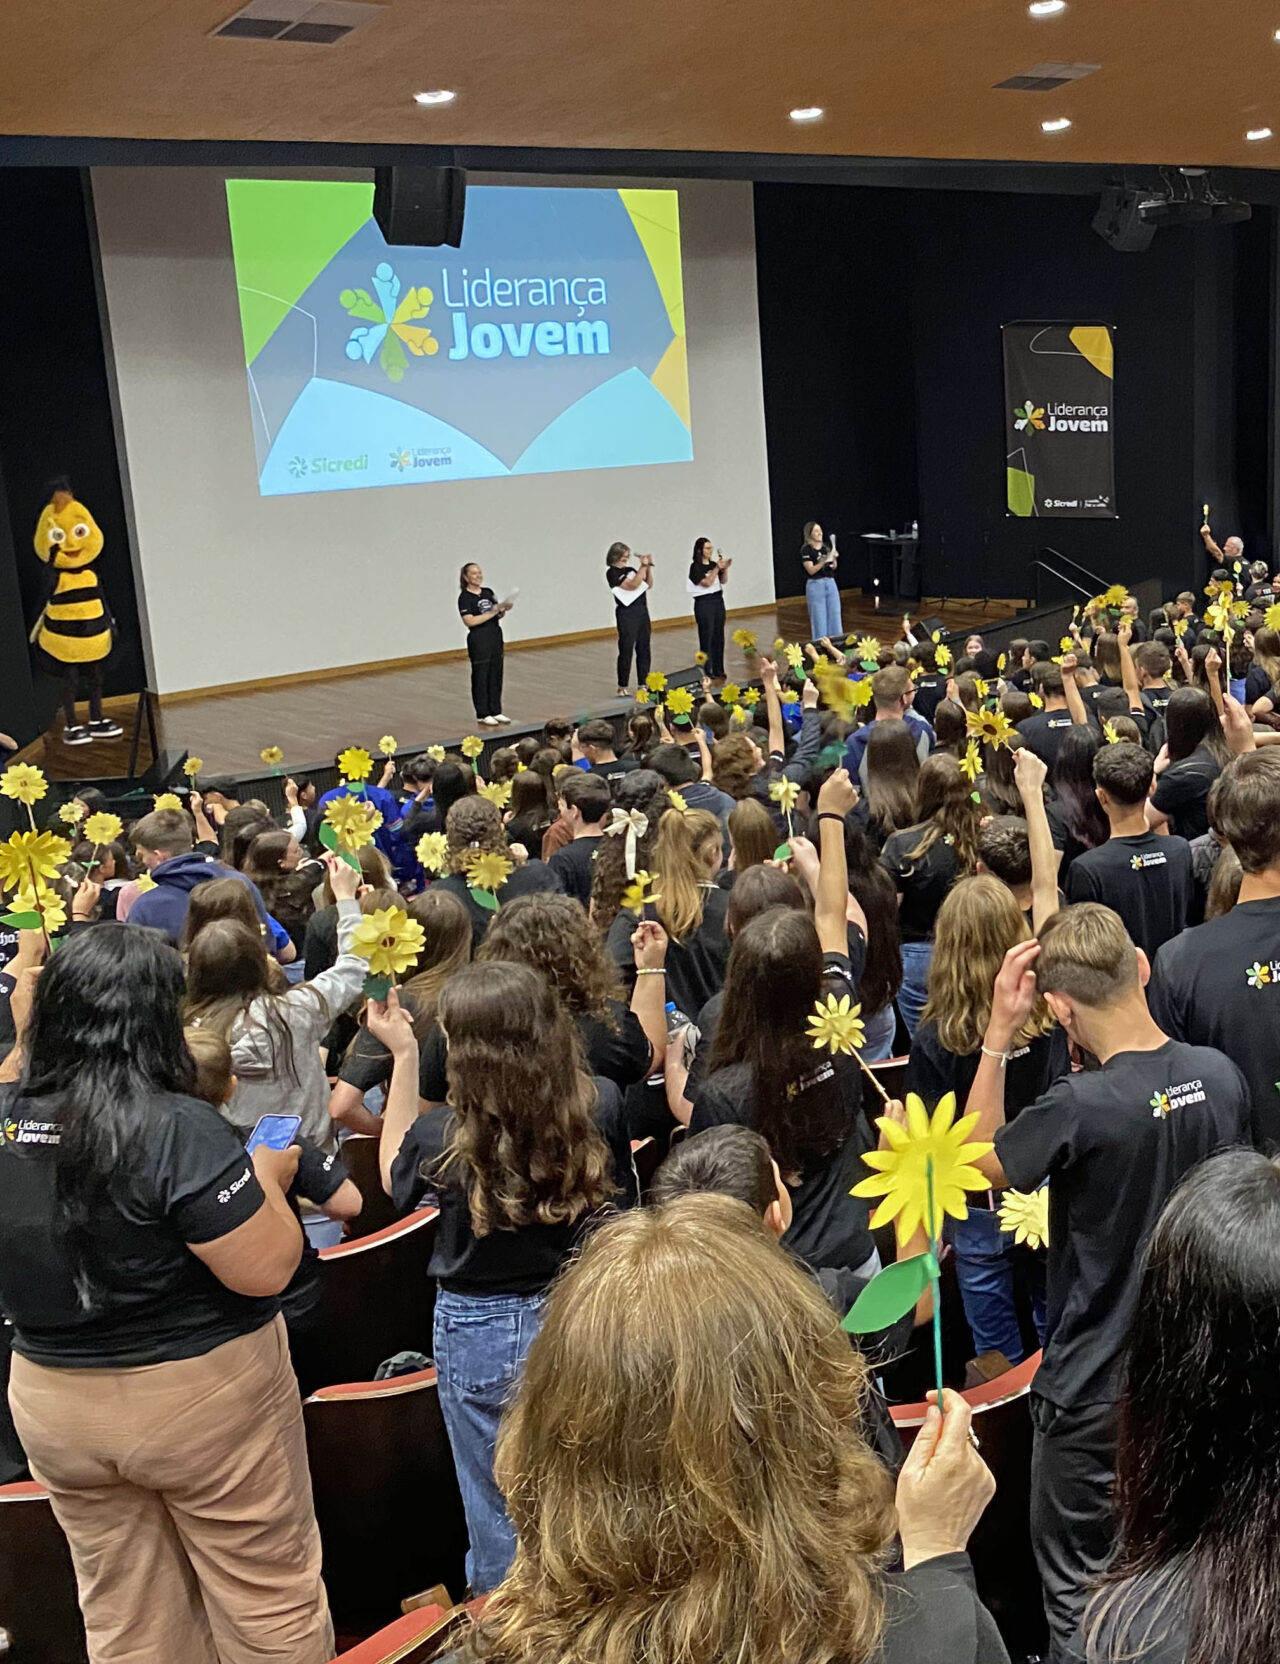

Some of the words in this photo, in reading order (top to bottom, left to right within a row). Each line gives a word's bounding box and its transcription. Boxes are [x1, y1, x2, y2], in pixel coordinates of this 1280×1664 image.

[441, 266, 607, 317] Liderança
[448, 311, 611, 361] Jovem
[1047, 402, 1109, 419] Liderança
[1047, 416, 1109, 432] Jovem
[311, 454, 369, 474] Sicredi
[413, 455, 452, 468] Jovem
[1165, 1079, 1203, 1098] Lerança
[1169, 1090, 1206, 1111] ovem
[15, 1130, 61, 1144] Jovem
